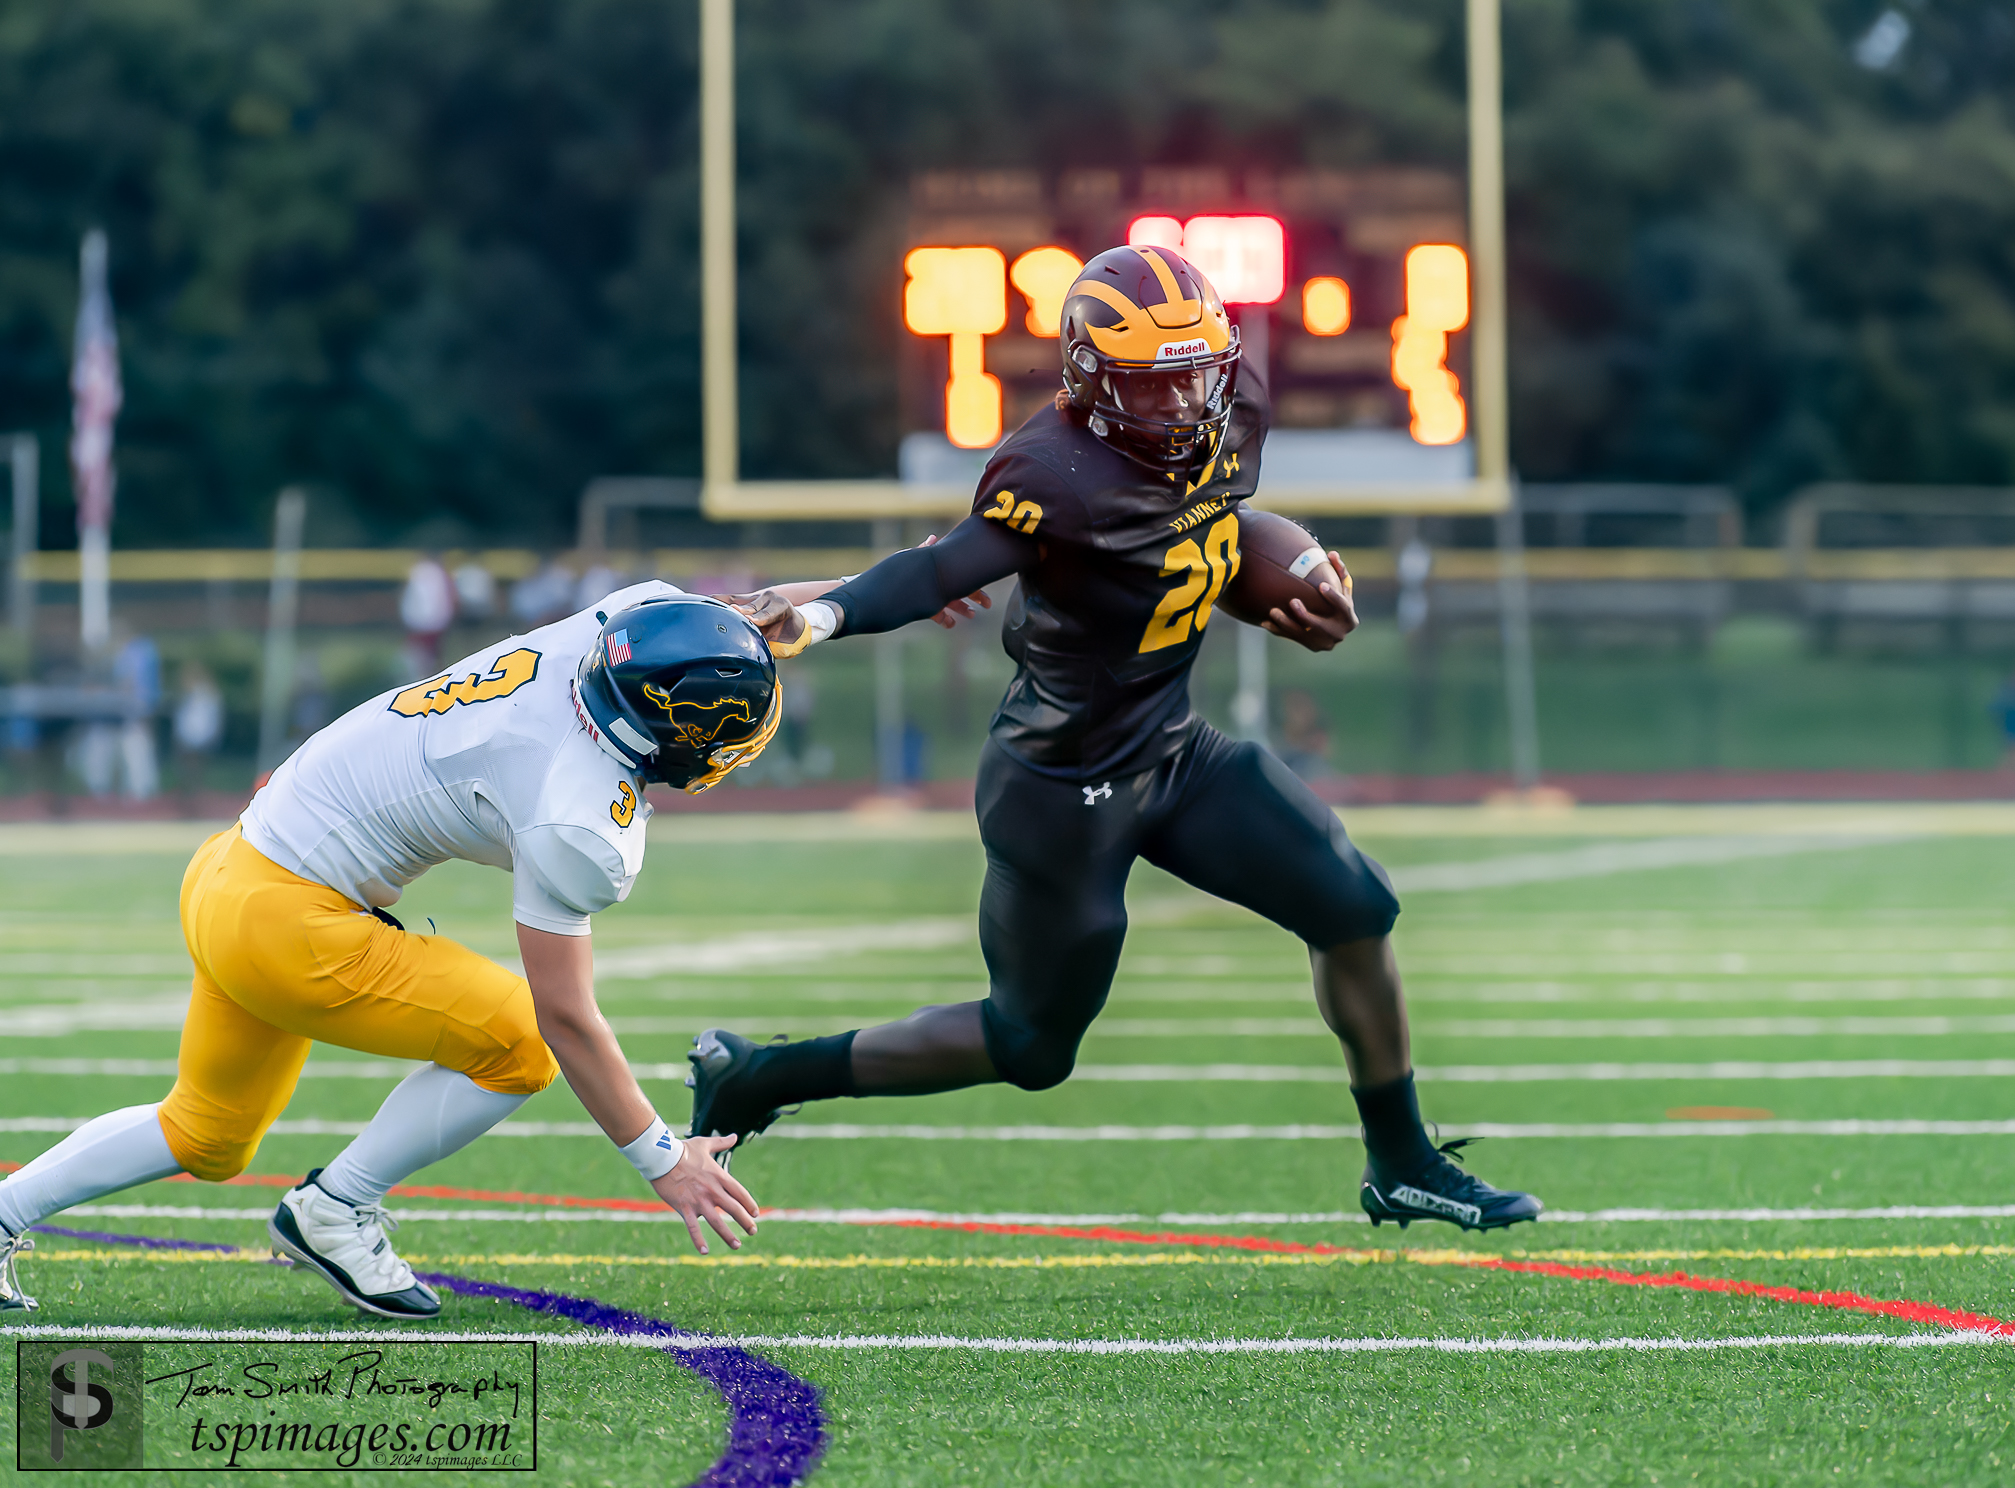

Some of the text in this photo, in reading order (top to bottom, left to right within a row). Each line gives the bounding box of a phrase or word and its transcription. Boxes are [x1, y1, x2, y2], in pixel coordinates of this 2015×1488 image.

[1164, 342, 1206, 358] Riddell
[1206, 373, 1229, 410] Riddell
[983, 490, 1043, 535] 20
[1138, 513, 1242, 654] 20
[387, 647, 543, 718] 3
[610, 780, 637, 828] 3
